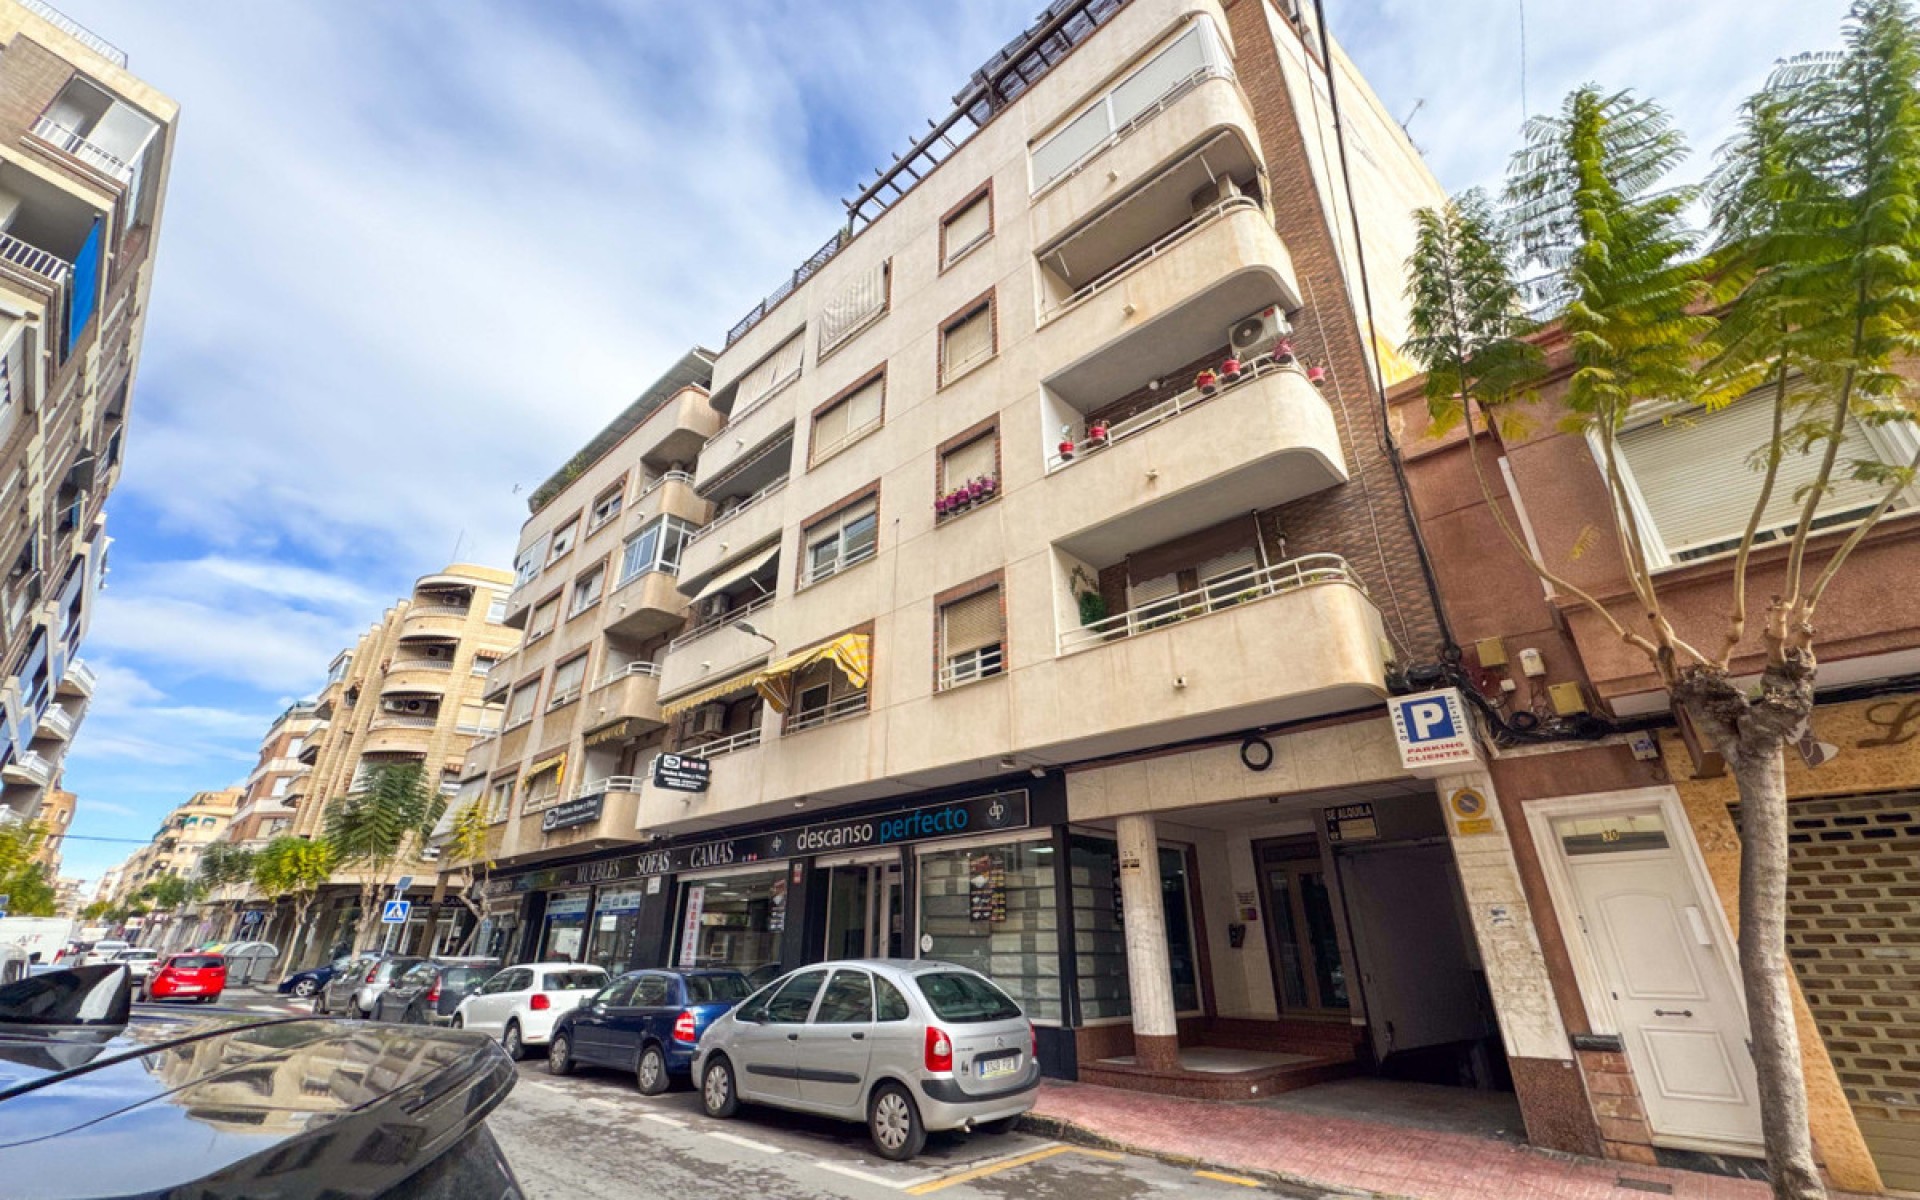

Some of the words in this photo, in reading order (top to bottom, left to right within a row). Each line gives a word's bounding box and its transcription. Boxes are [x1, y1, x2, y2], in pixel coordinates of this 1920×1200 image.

[1411, 703, 1444, 740] P
[1406, 749, 1470, 763] CLIENTES
[1407, 742, 1465, 755] PARKING
[797, 822, 873, 850] descanso
[880, 808, 968, 845] perfecto
[690, 841, 735, 869] CAMAS
